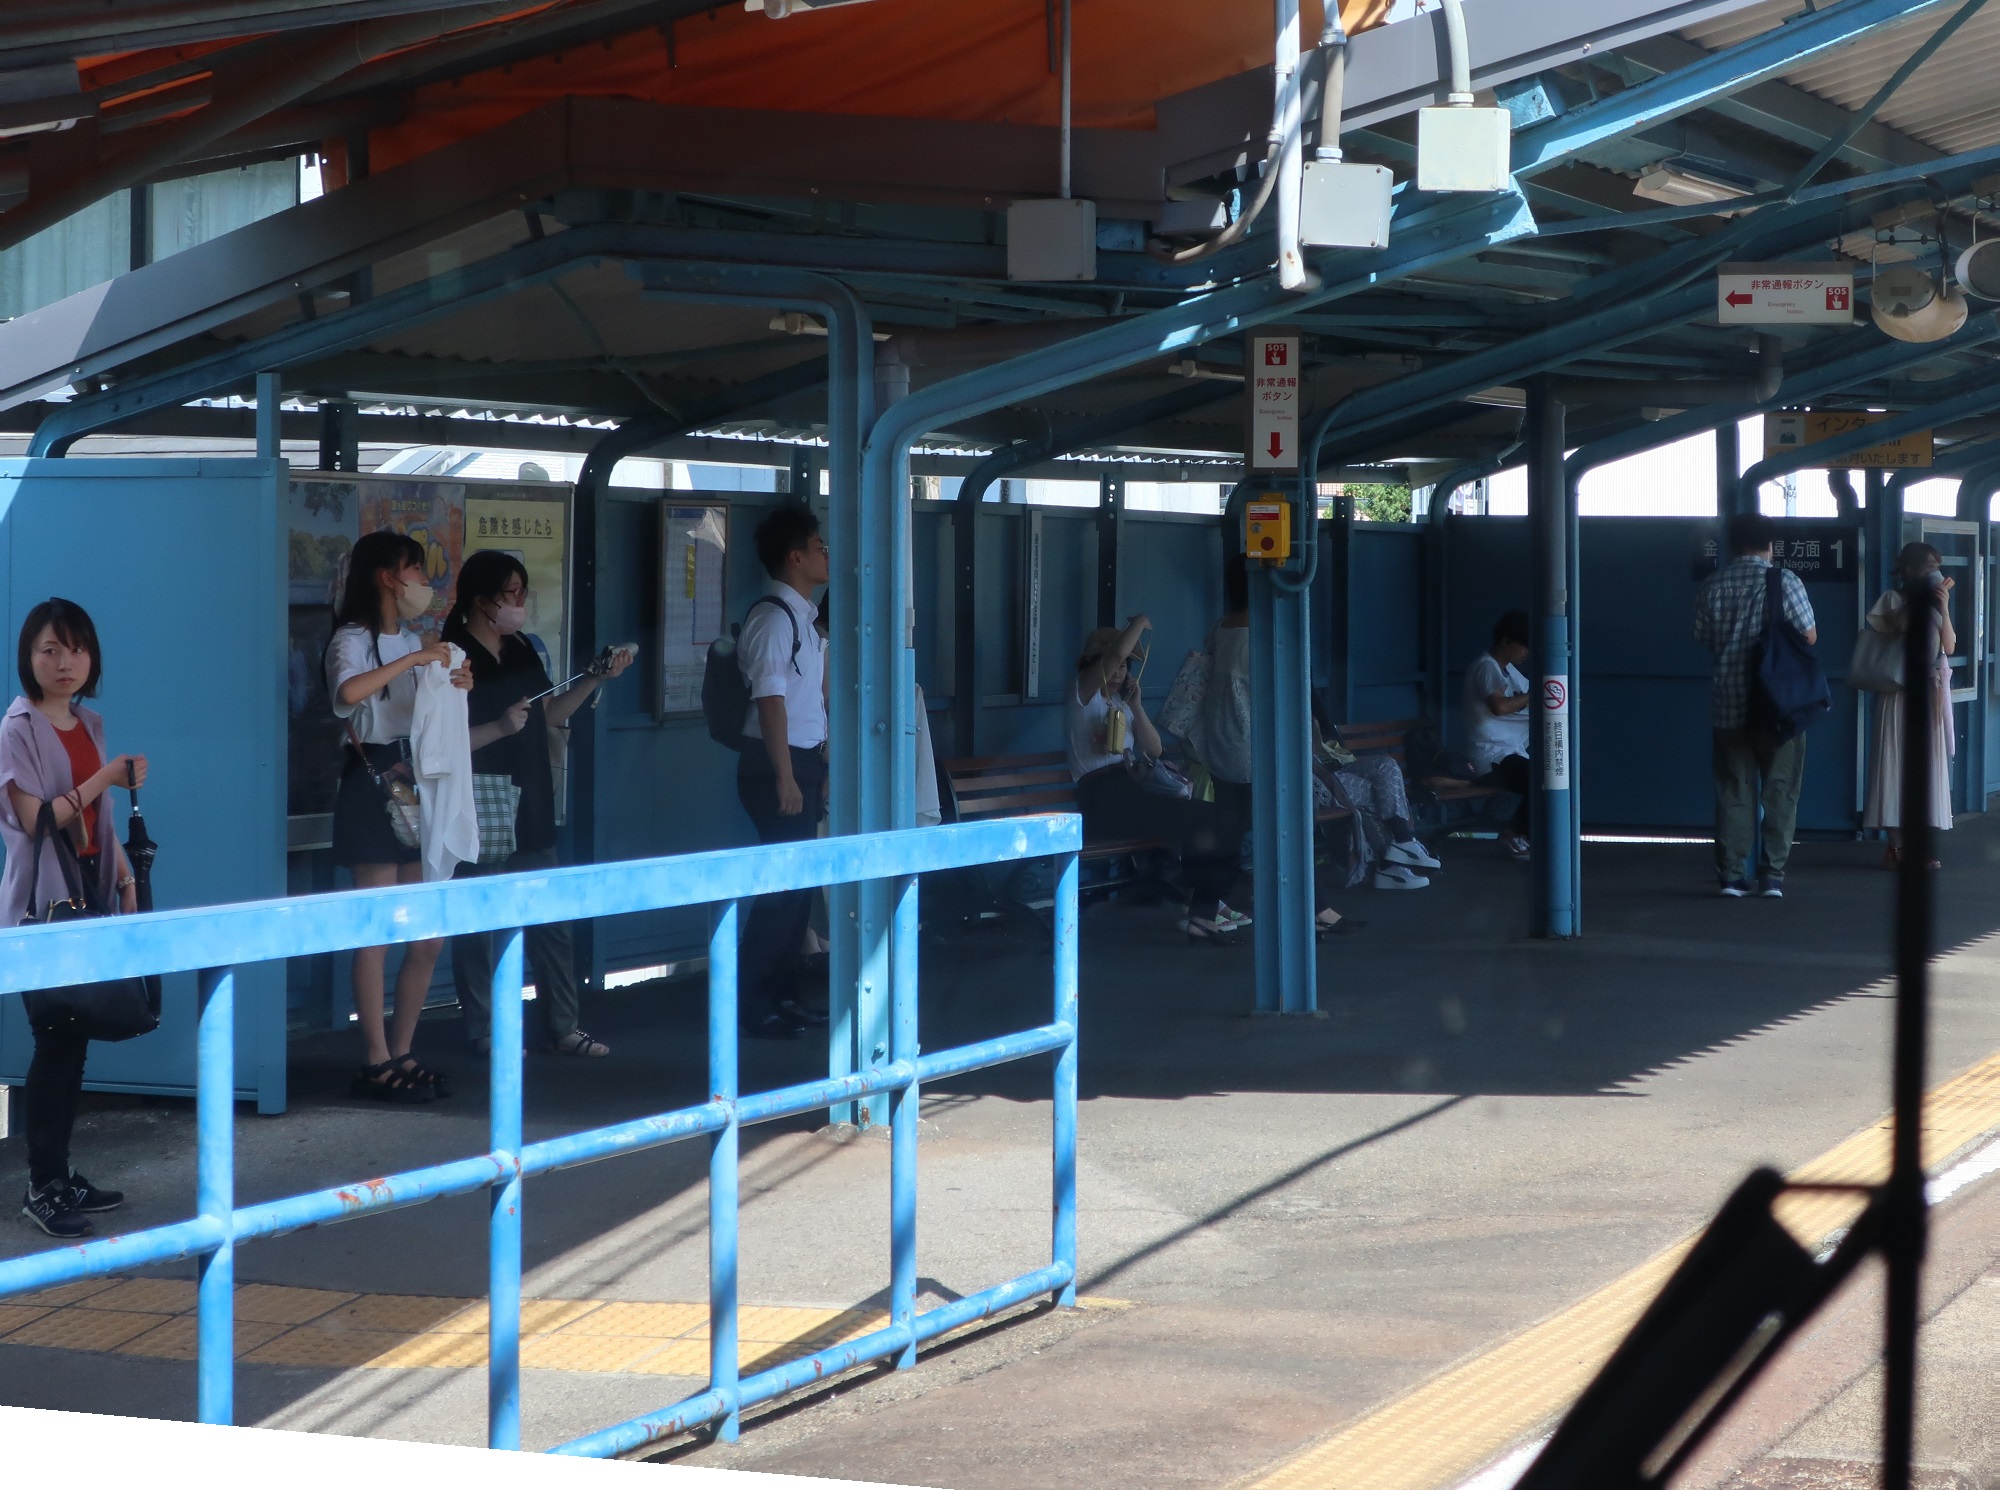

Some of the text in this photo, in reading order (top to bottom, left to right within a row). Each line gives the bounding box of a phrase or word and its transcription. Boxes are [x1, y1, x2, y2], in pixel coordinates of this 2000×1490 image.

[1750, 279, 1824, 290] 非常通報ボタン
[1828, 287, 1847, 296] SOS
[1267, 344, 1285, 352] SOS
[1256, 377, 1297, 388] 非常通報
[1262, 391, 1293, 401] ボタン
[1817, 417, 1867, 433] インタ
[478, 516, 552, 536] 危険を感じたら
[1791, 540, 1821, 557] 方面
[1830, 539, 1843, 569] 1
